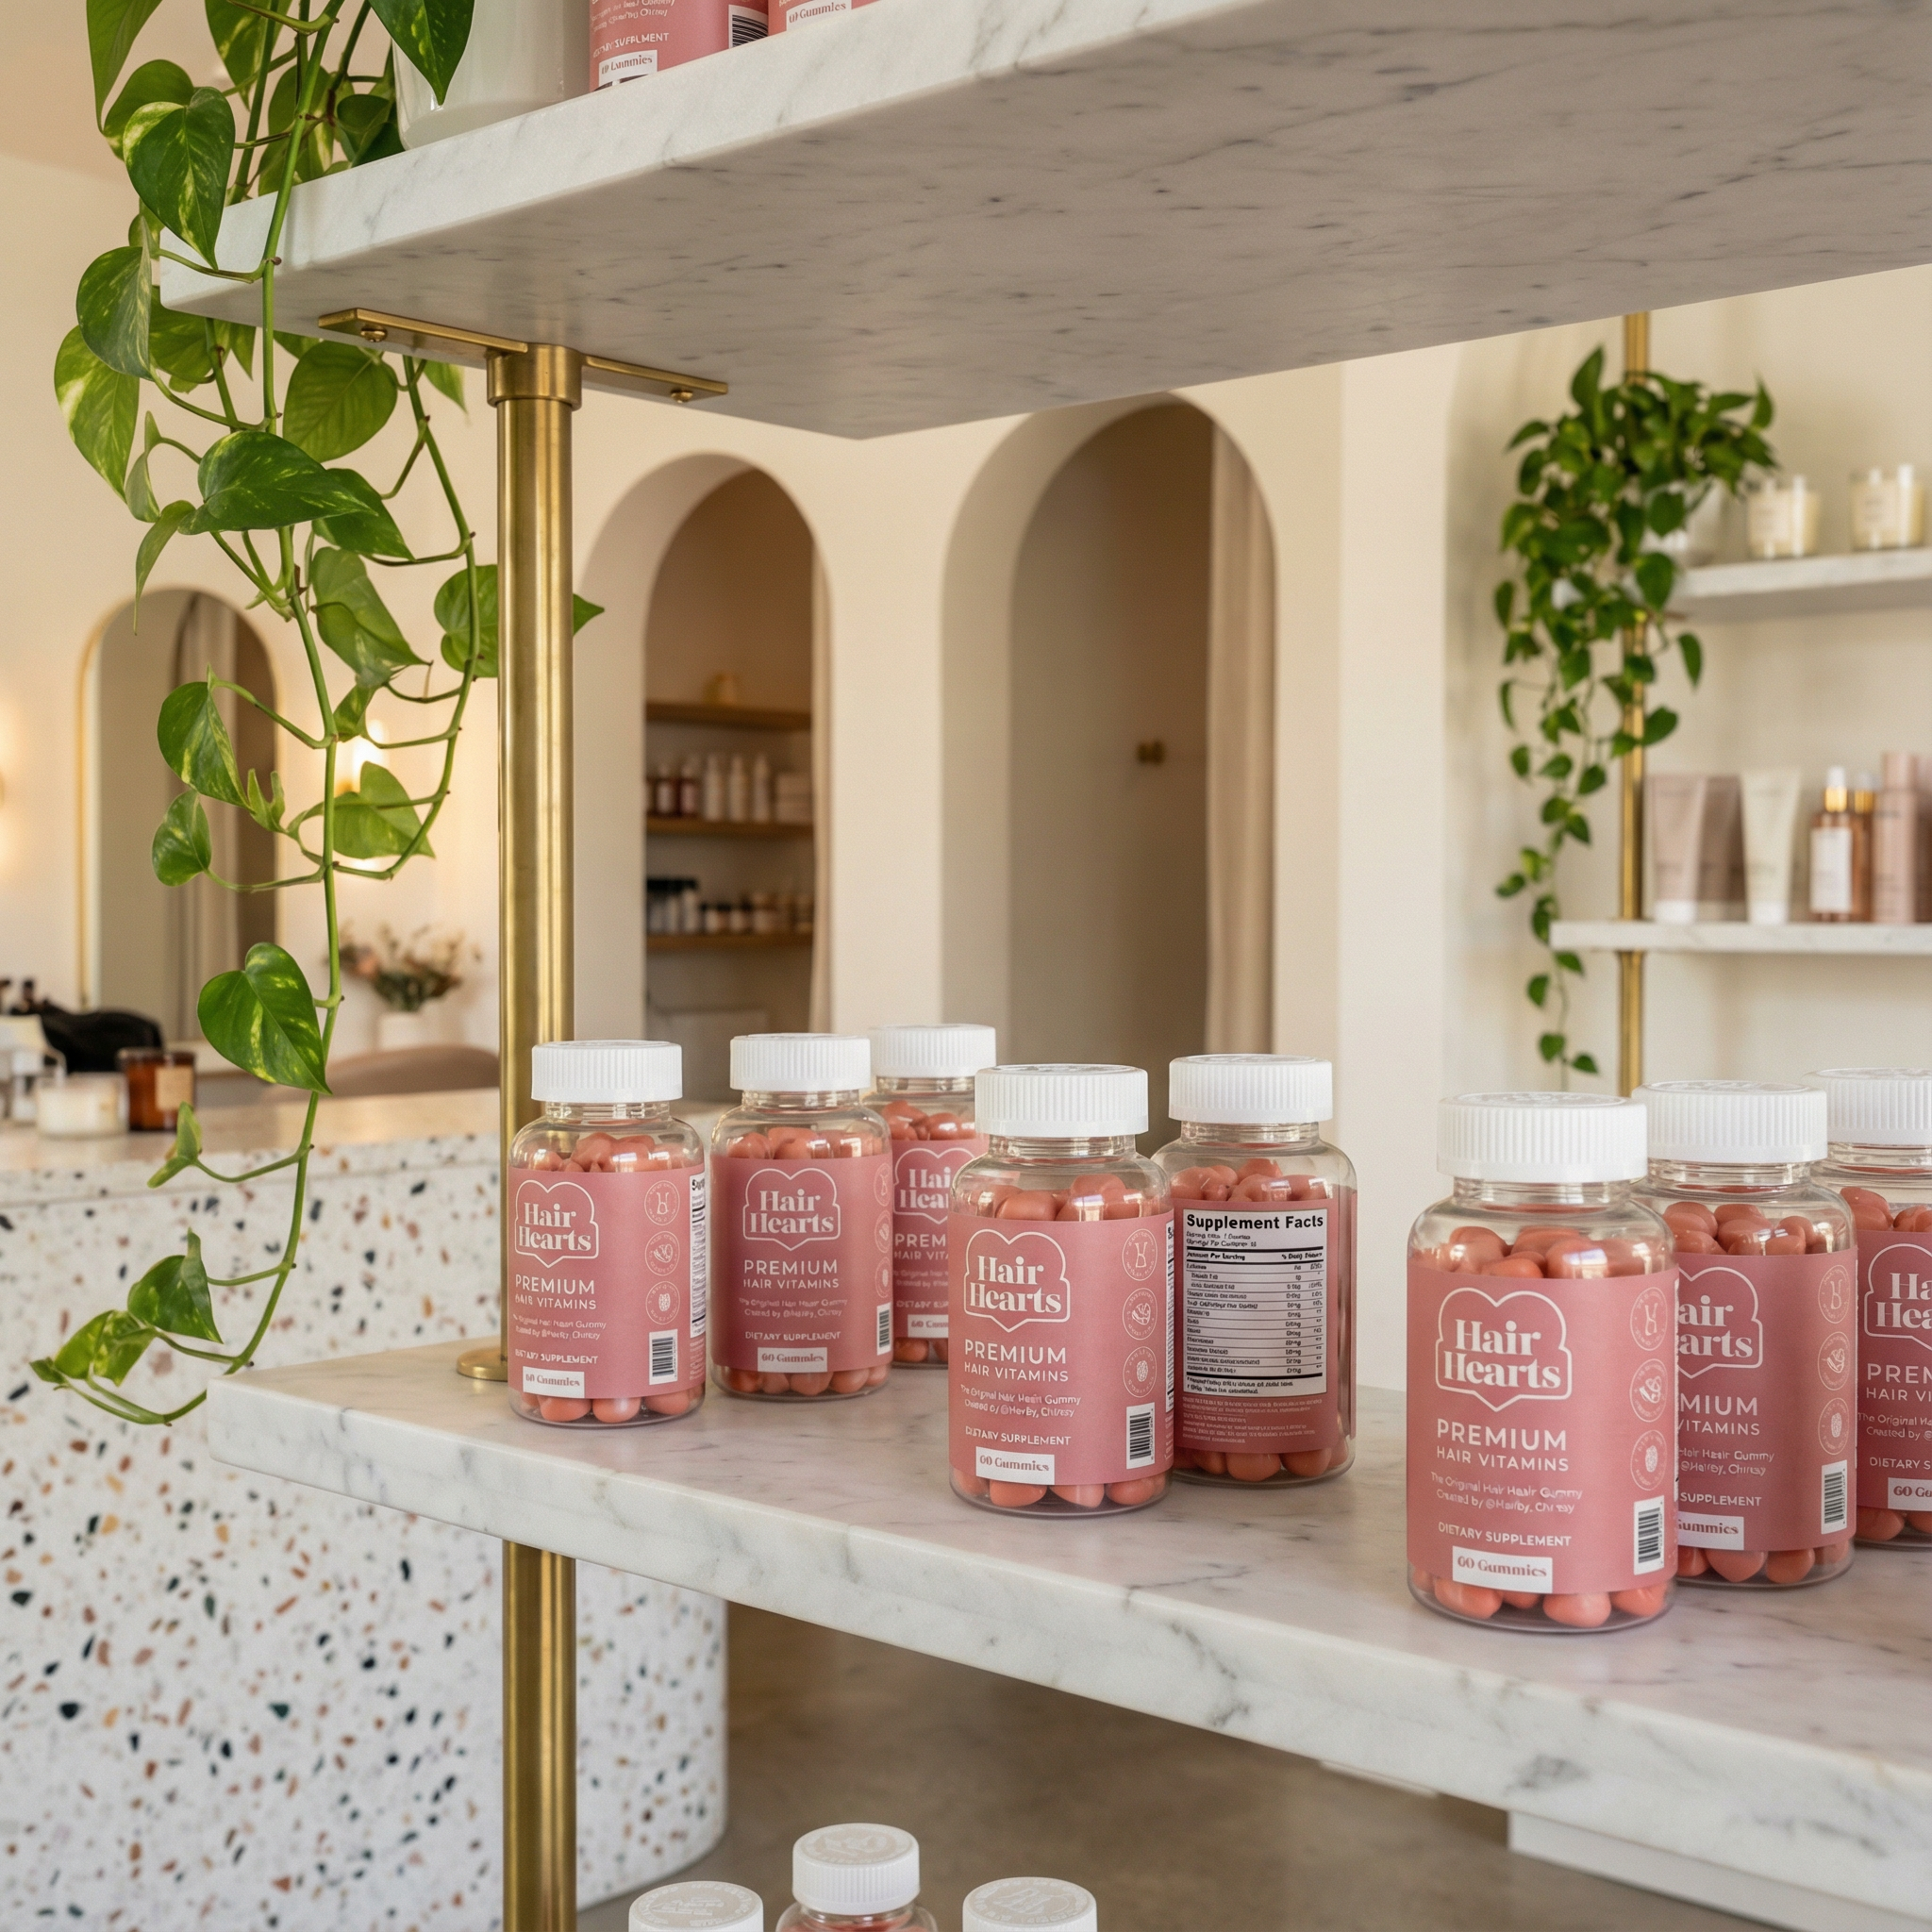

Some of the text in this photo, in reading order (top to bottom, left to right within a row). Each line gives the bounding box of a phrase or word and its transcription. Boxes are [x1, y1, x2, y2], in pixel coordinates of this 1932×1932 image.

[908, 1166, 952, 1189] Hai
[759, 1189, 821, 1212] Hair
[524, 1202, 576, 1228] Hair
[750, 1212, 834, 1234] Hearts
[1187, 1213, 1324, 1232] Supplement Facts
[519, 1226, 591, 1252] Hearts
[894, 1234, 946, 1248] PREM
[743, 1259, 838, 1275] PREMIUM
[976, 1256, 1044, 1285] Hair
[515, 1274, 595, 1295] PREMIUM
[743, 1278, 840, 1290] HAIR VITAMINS
[1889, 1273, 1932, 1300] Ha
[538, 1297, 597, 1310] VITAMINS
[970, 1282, 1061, 1313] Hearts
[1678, 1295, 1734, 1327] air
[1874, 1301, 1932, 1329] Hea
[1455, 1319, 1541, 1357] Hair
[1678, 1333, 1753, 1358] arts
[964, 1339, 1067, 1364] PREMIUM
[964, 1362, 1069, 1383] HAIR VITAMINS
[1443, 1350, 1561, 1390] Hearts
[1679, 1392, 1758, 1417] MIUM
[1866, 1387, 1907, 1401] HAIR
[1000, 1432, 1072, 1445] SUPPLEMENT
[1437, 1418, 1567, 1452] PREMIUM
[1437, 1445, 1569, 1472] HAIR VITAMINS
[1734, 1450, 1774, 1463] Gummy
[1869, 1457, 1921, 1470] DIETARY
[1680, 1491, 1762, 1507] SUPPLEMENT
[1893, 1485, 1913, 1497] 60
[1438, 1522, 1573, 1546] DIETARY SUPPLEMENT
